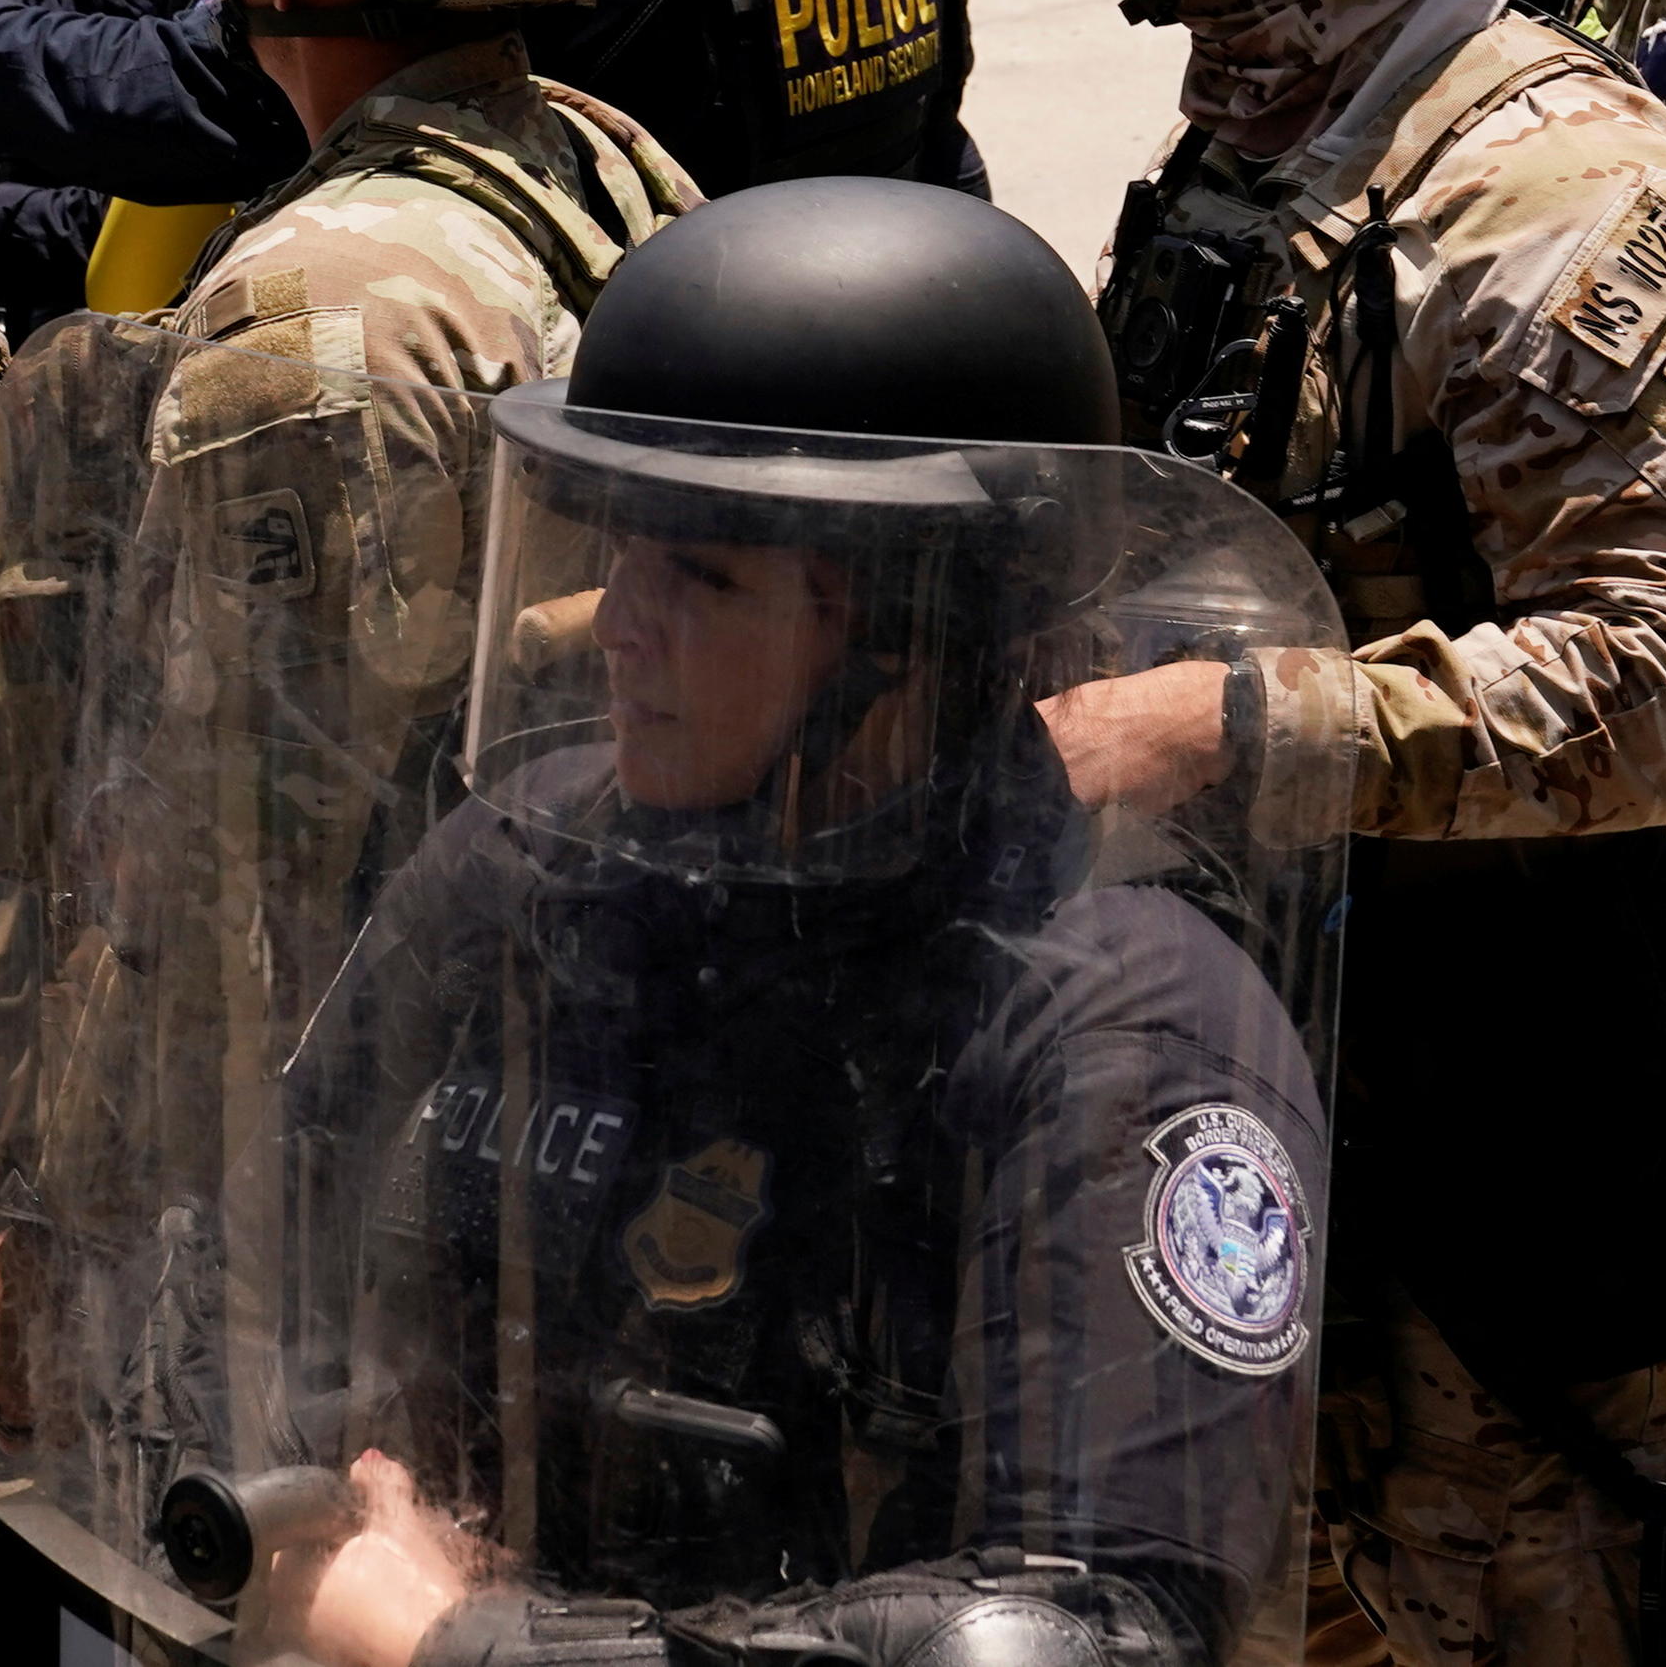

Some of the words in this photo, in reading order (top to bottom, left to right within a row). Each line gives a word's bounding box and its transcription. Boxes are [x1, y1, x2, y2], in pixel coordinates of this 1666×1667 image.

[787, 55, 884, 117] HOMELAND
[1573, 282, 1643, 348] NS
[409, 1085, 623, 1184] POLICE
[1185, 1127, 1241, 1153] BORDER
[1196, 1112, 1224, 1131] U.S.
[1165, 1294, 1204, 1335] FIELD
[1205, 1327, 1281, 1360] OPERATIONS
